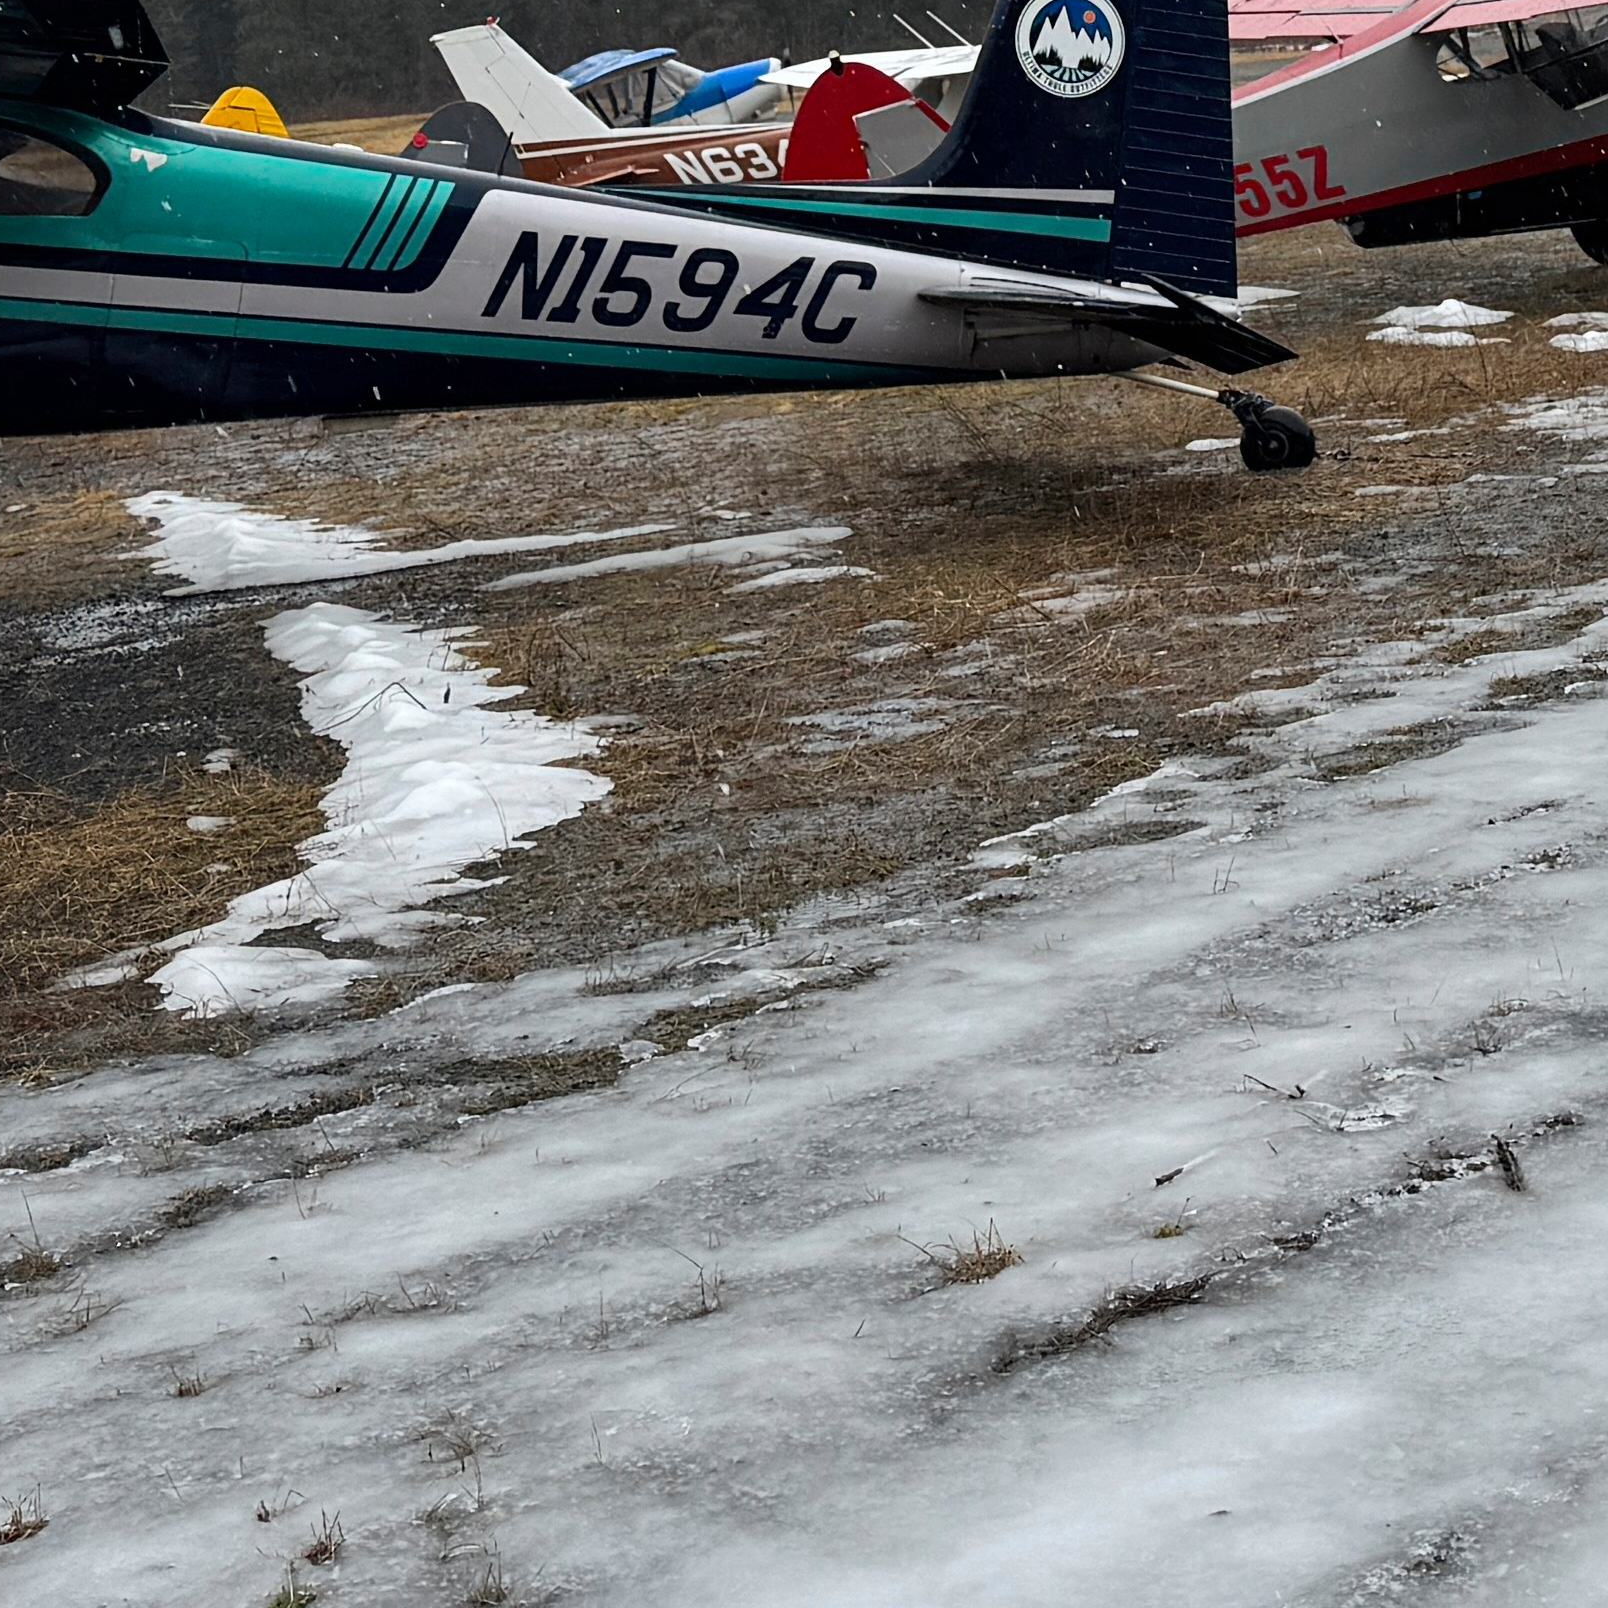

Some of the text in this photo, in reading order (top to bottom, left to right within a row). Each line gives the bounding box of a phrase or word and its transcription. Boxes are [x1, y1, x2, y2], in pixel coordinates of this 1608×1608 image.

[1022, 50, 1113, 93] ULTIMA THULE OUTFITTERS
[1233, 144, 1347, 218] 55Z
[481, 230, 878, 344] N1594C
